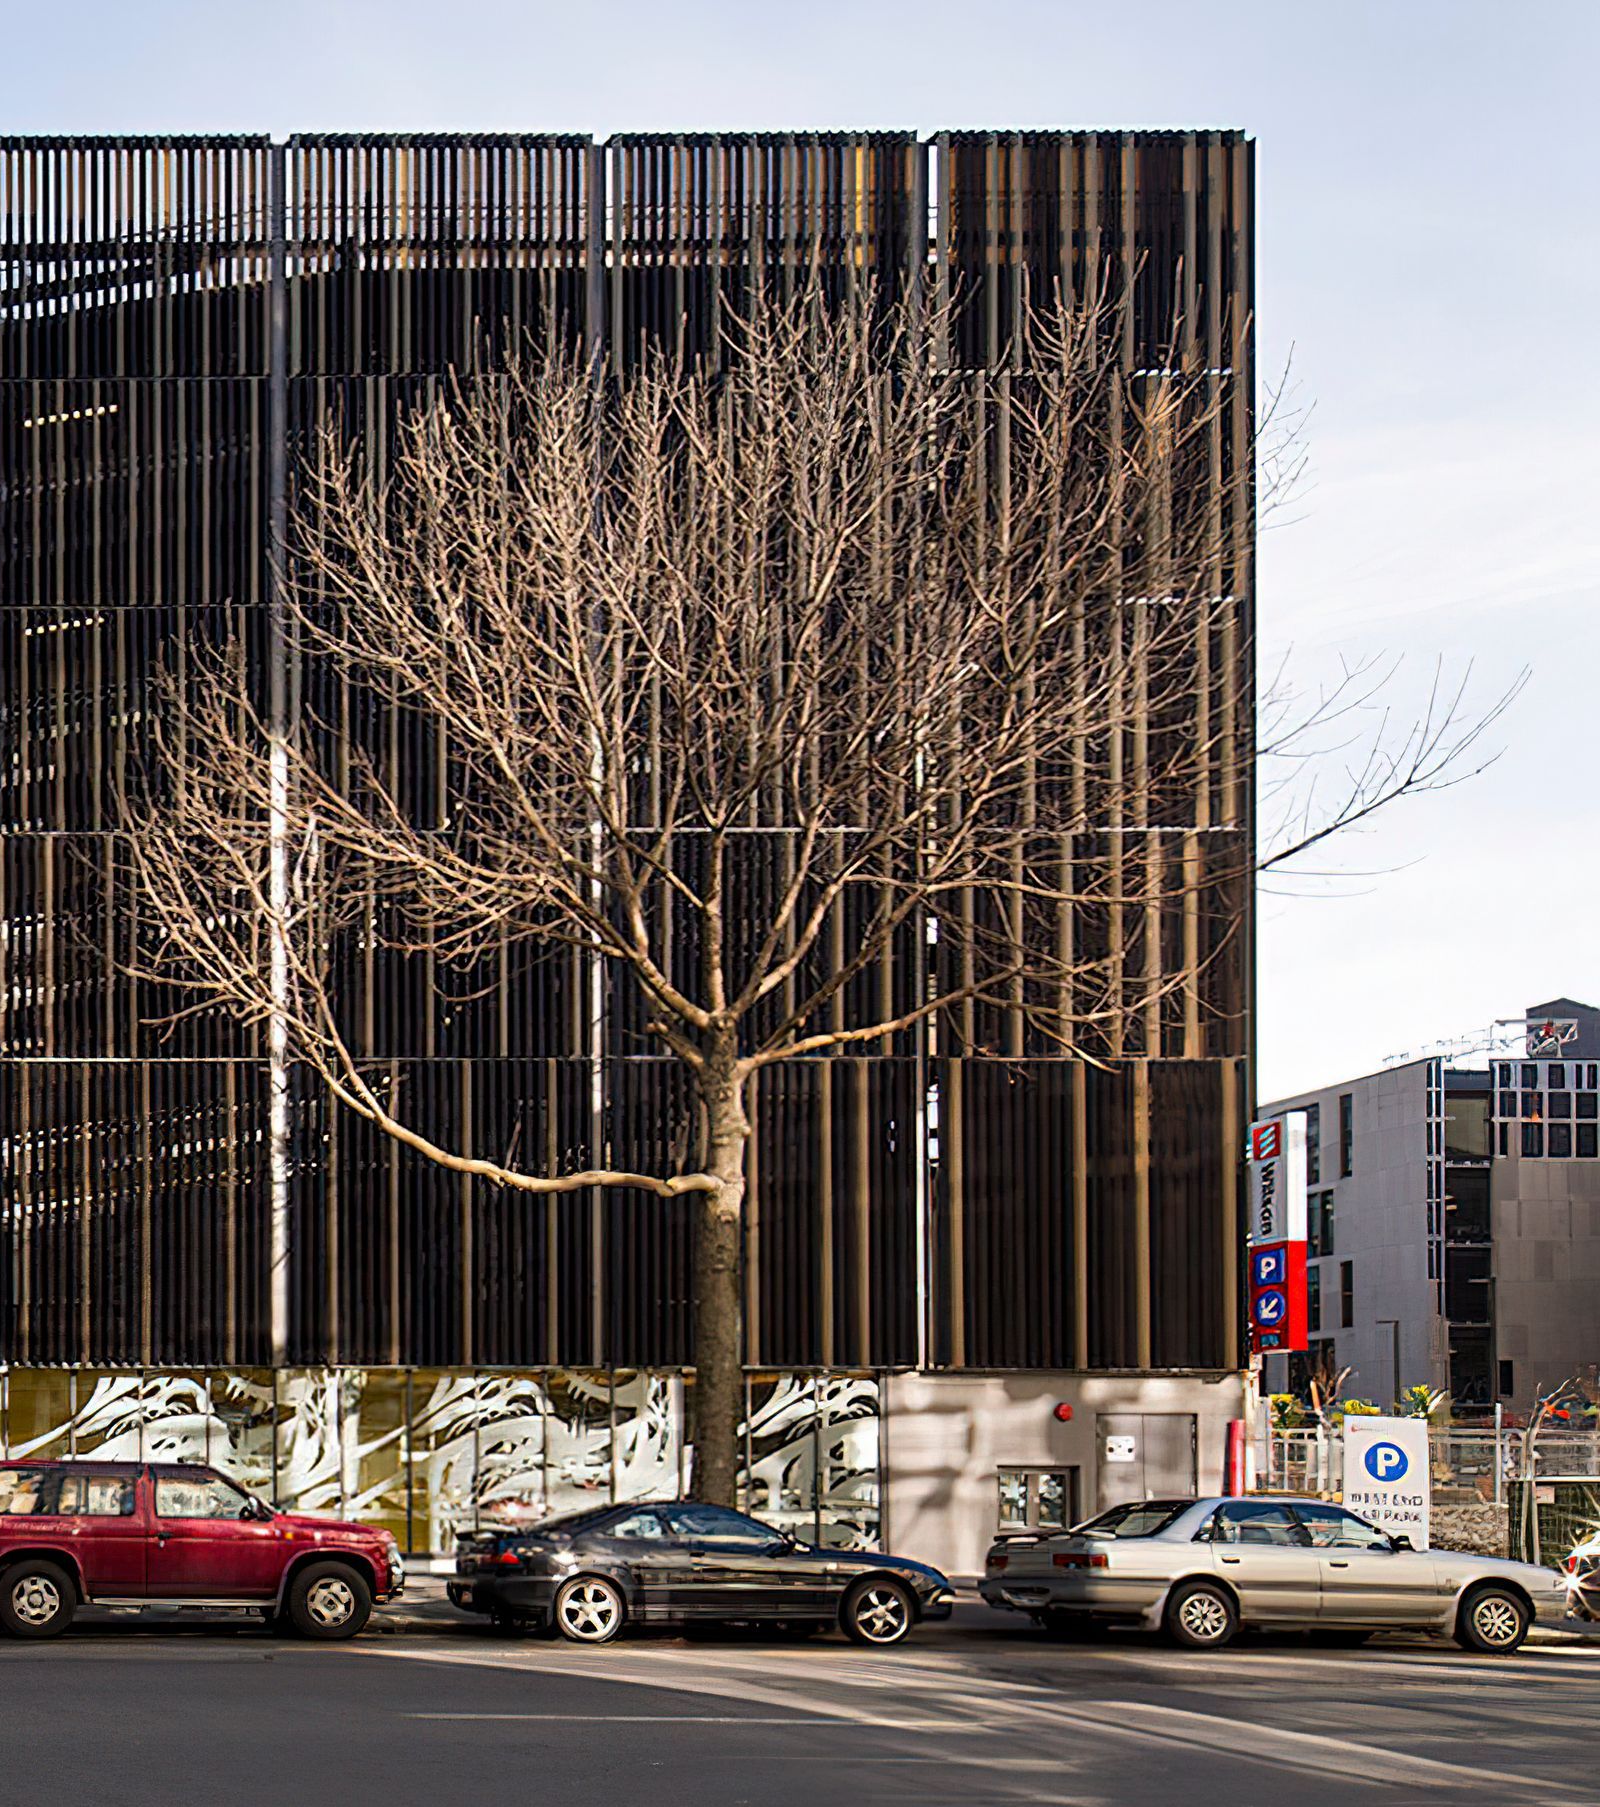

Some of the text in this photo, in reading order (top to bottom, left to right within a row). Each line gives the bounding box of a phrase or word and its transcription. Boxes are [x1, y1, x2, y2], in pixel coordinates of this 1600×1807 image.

[1260, 1160, 1276, 1236] Wilson
[1260, 1256, 1276, 1279] P
[1376, 1447, 1400, 1477] P
[1351, 1493, 1423, 1506] WEST END
[1384, 1509, 1422, 1523] PARK
